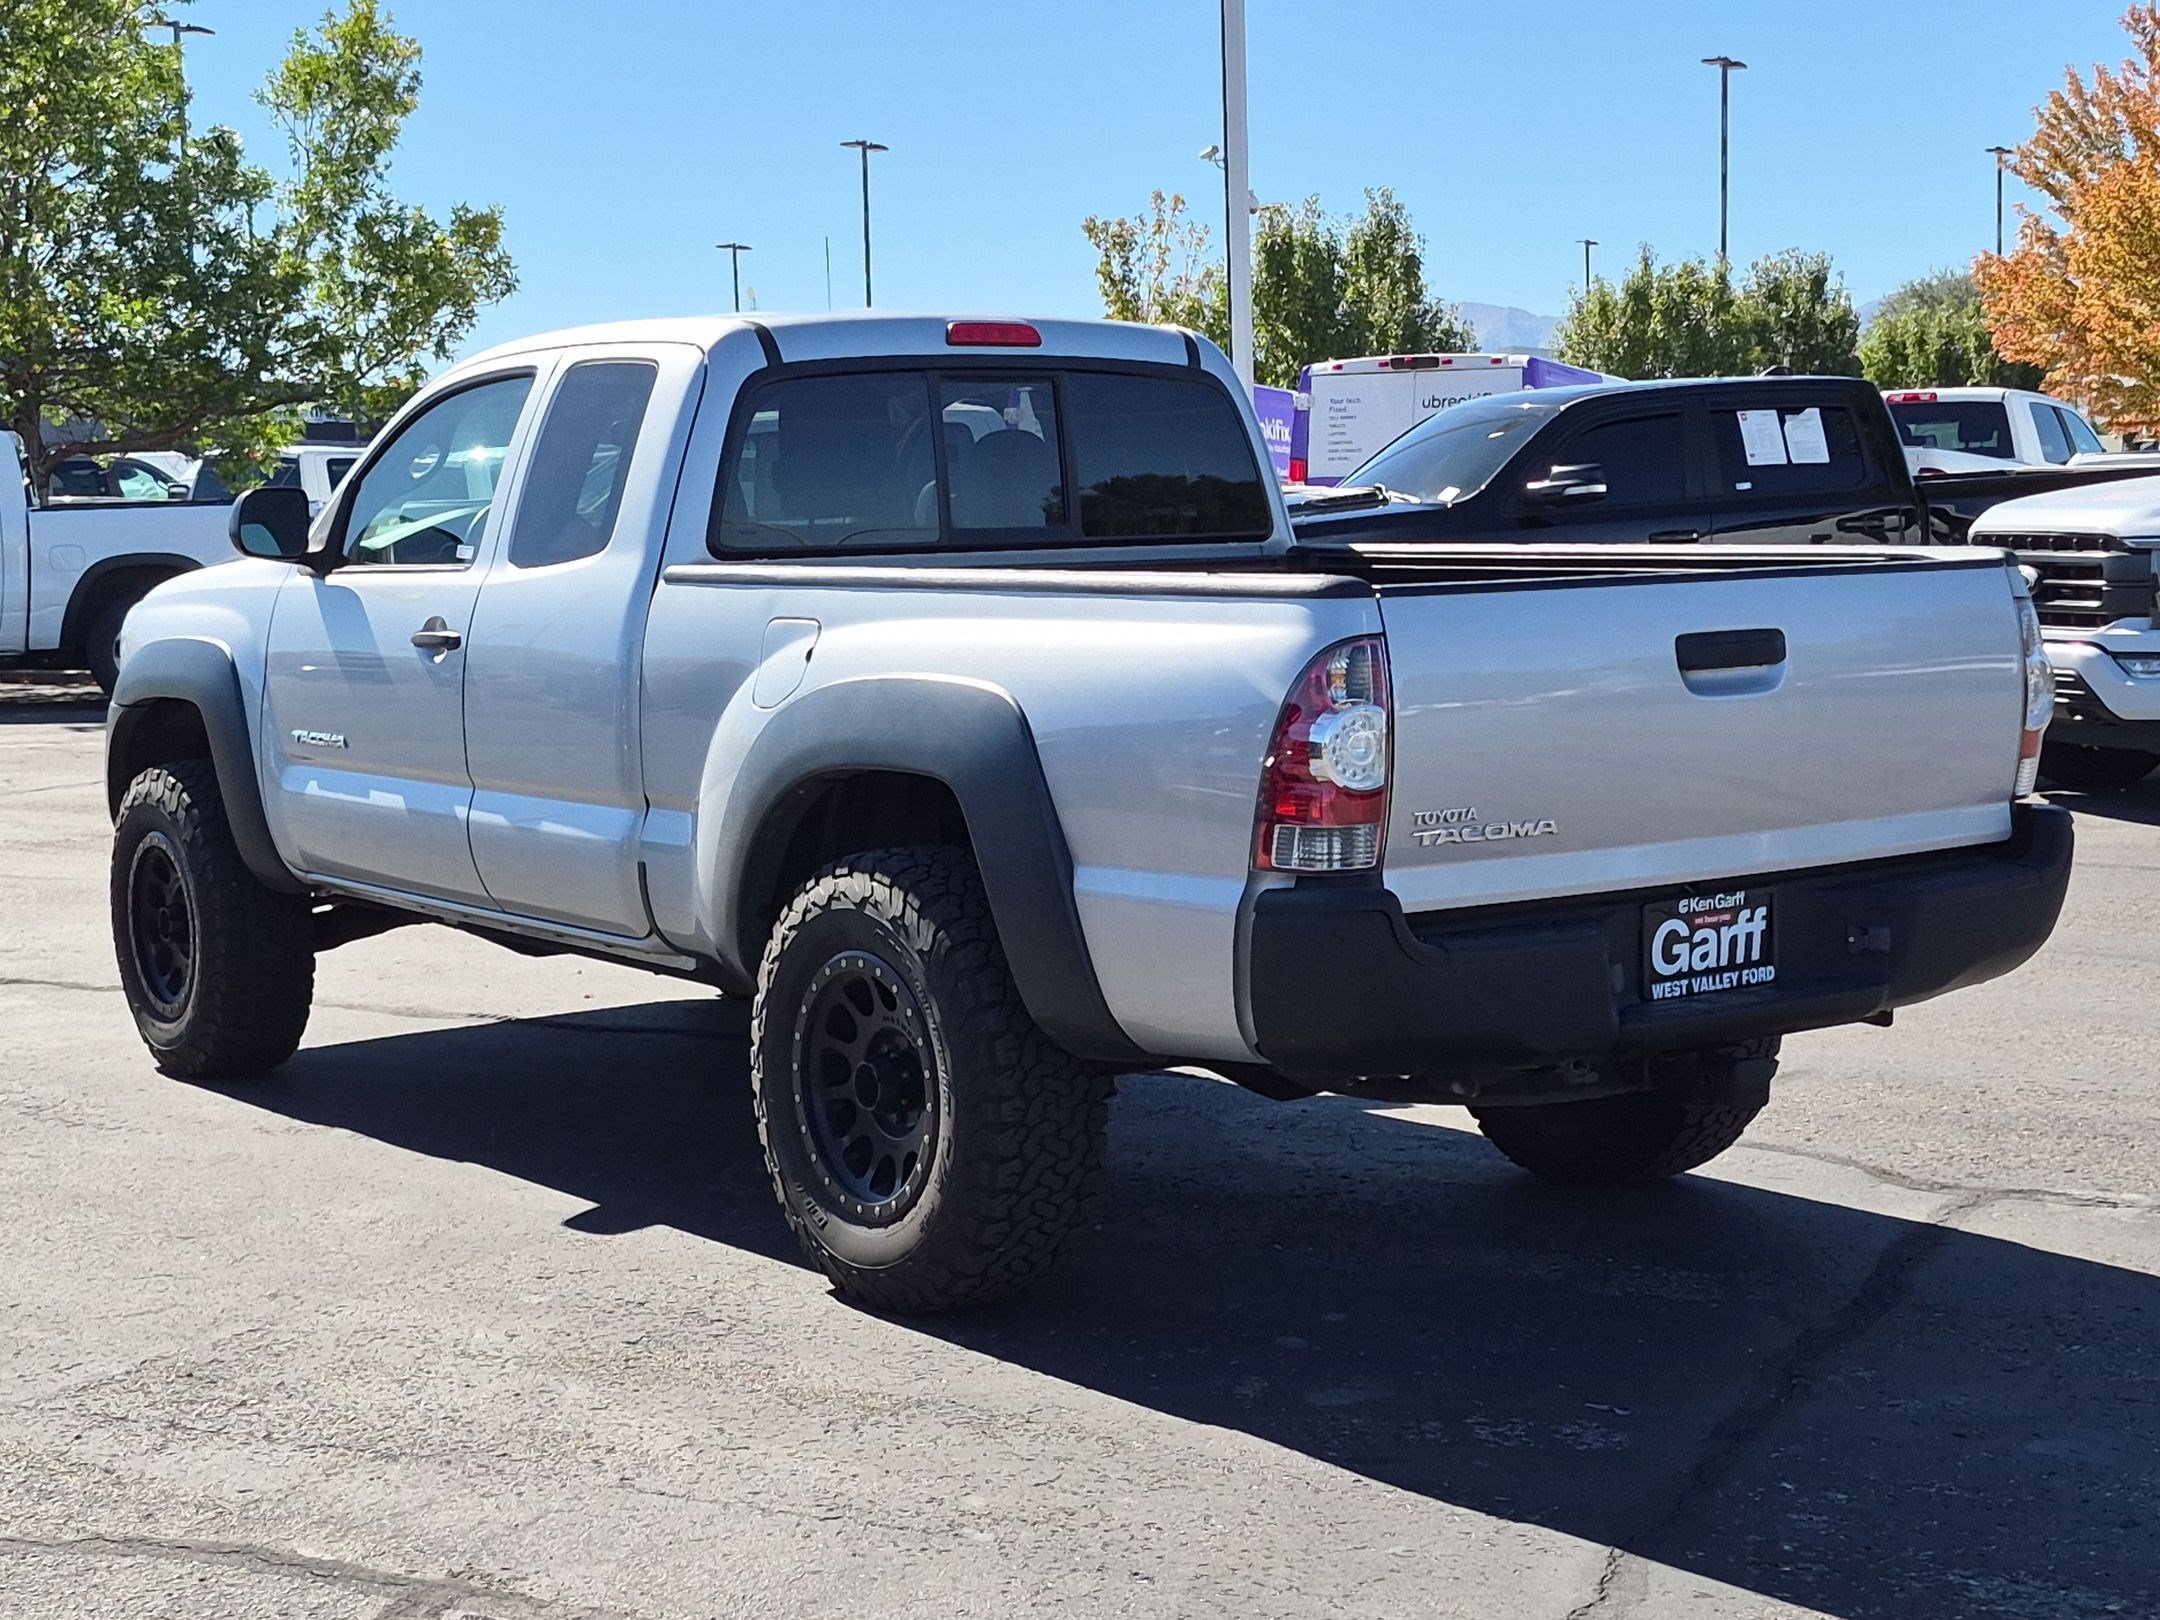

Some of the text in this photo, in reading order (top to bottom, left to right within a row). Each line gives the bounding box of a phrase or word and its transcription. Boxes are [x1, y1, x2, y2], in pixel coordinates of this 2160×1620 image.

[1414, 807, 1477, 825] TOYOTA
[1412, 819, 1558, 846] TACOMA
[1690, 891, 1745, 913] Ken Garff
[1652, 906, 1767, 976] Garff
[1652, 965, 1776, 1000] WEST VALLEY FORD
